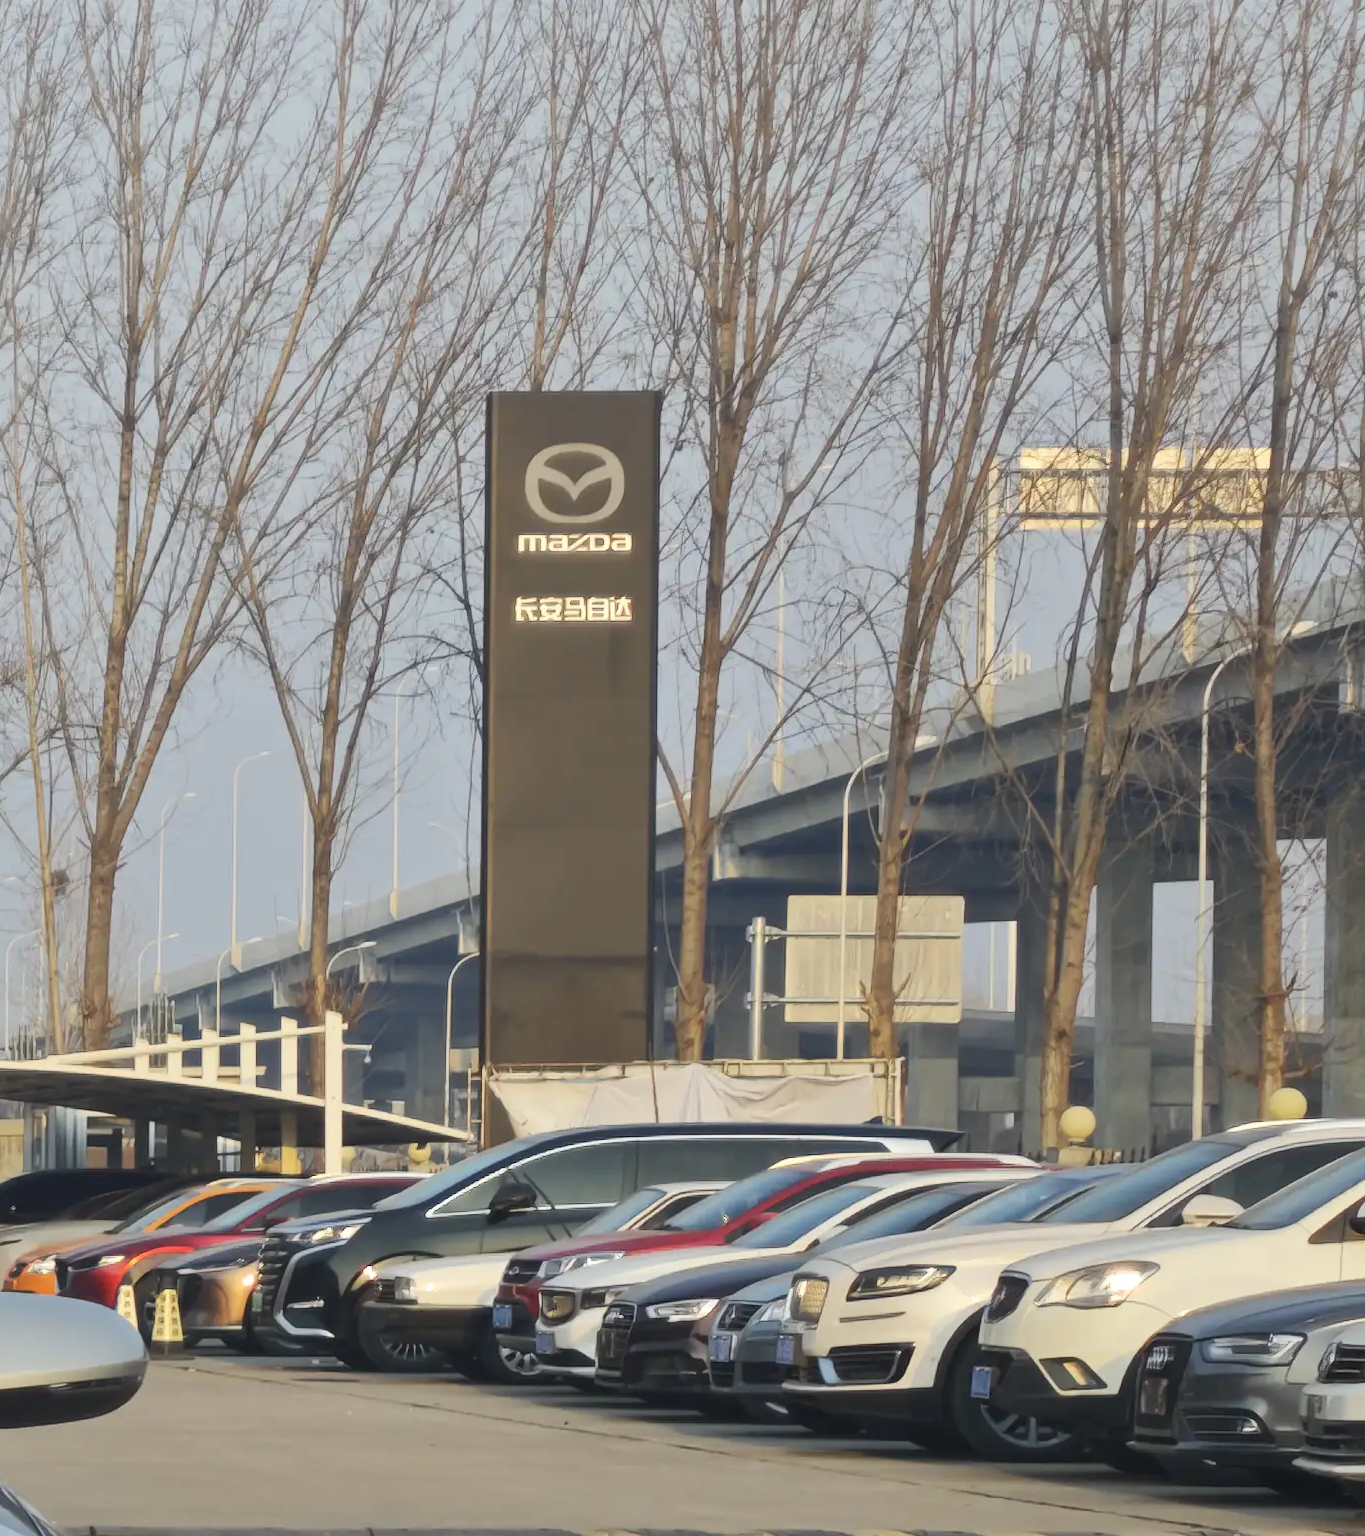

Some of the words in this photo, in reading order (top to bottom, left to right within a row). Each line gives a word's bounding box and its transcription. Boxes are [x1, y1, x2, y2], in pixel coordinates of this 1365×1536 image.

[517, 532, 633, 552] mazda
[514, 596, 633, 622] 长安马自达
